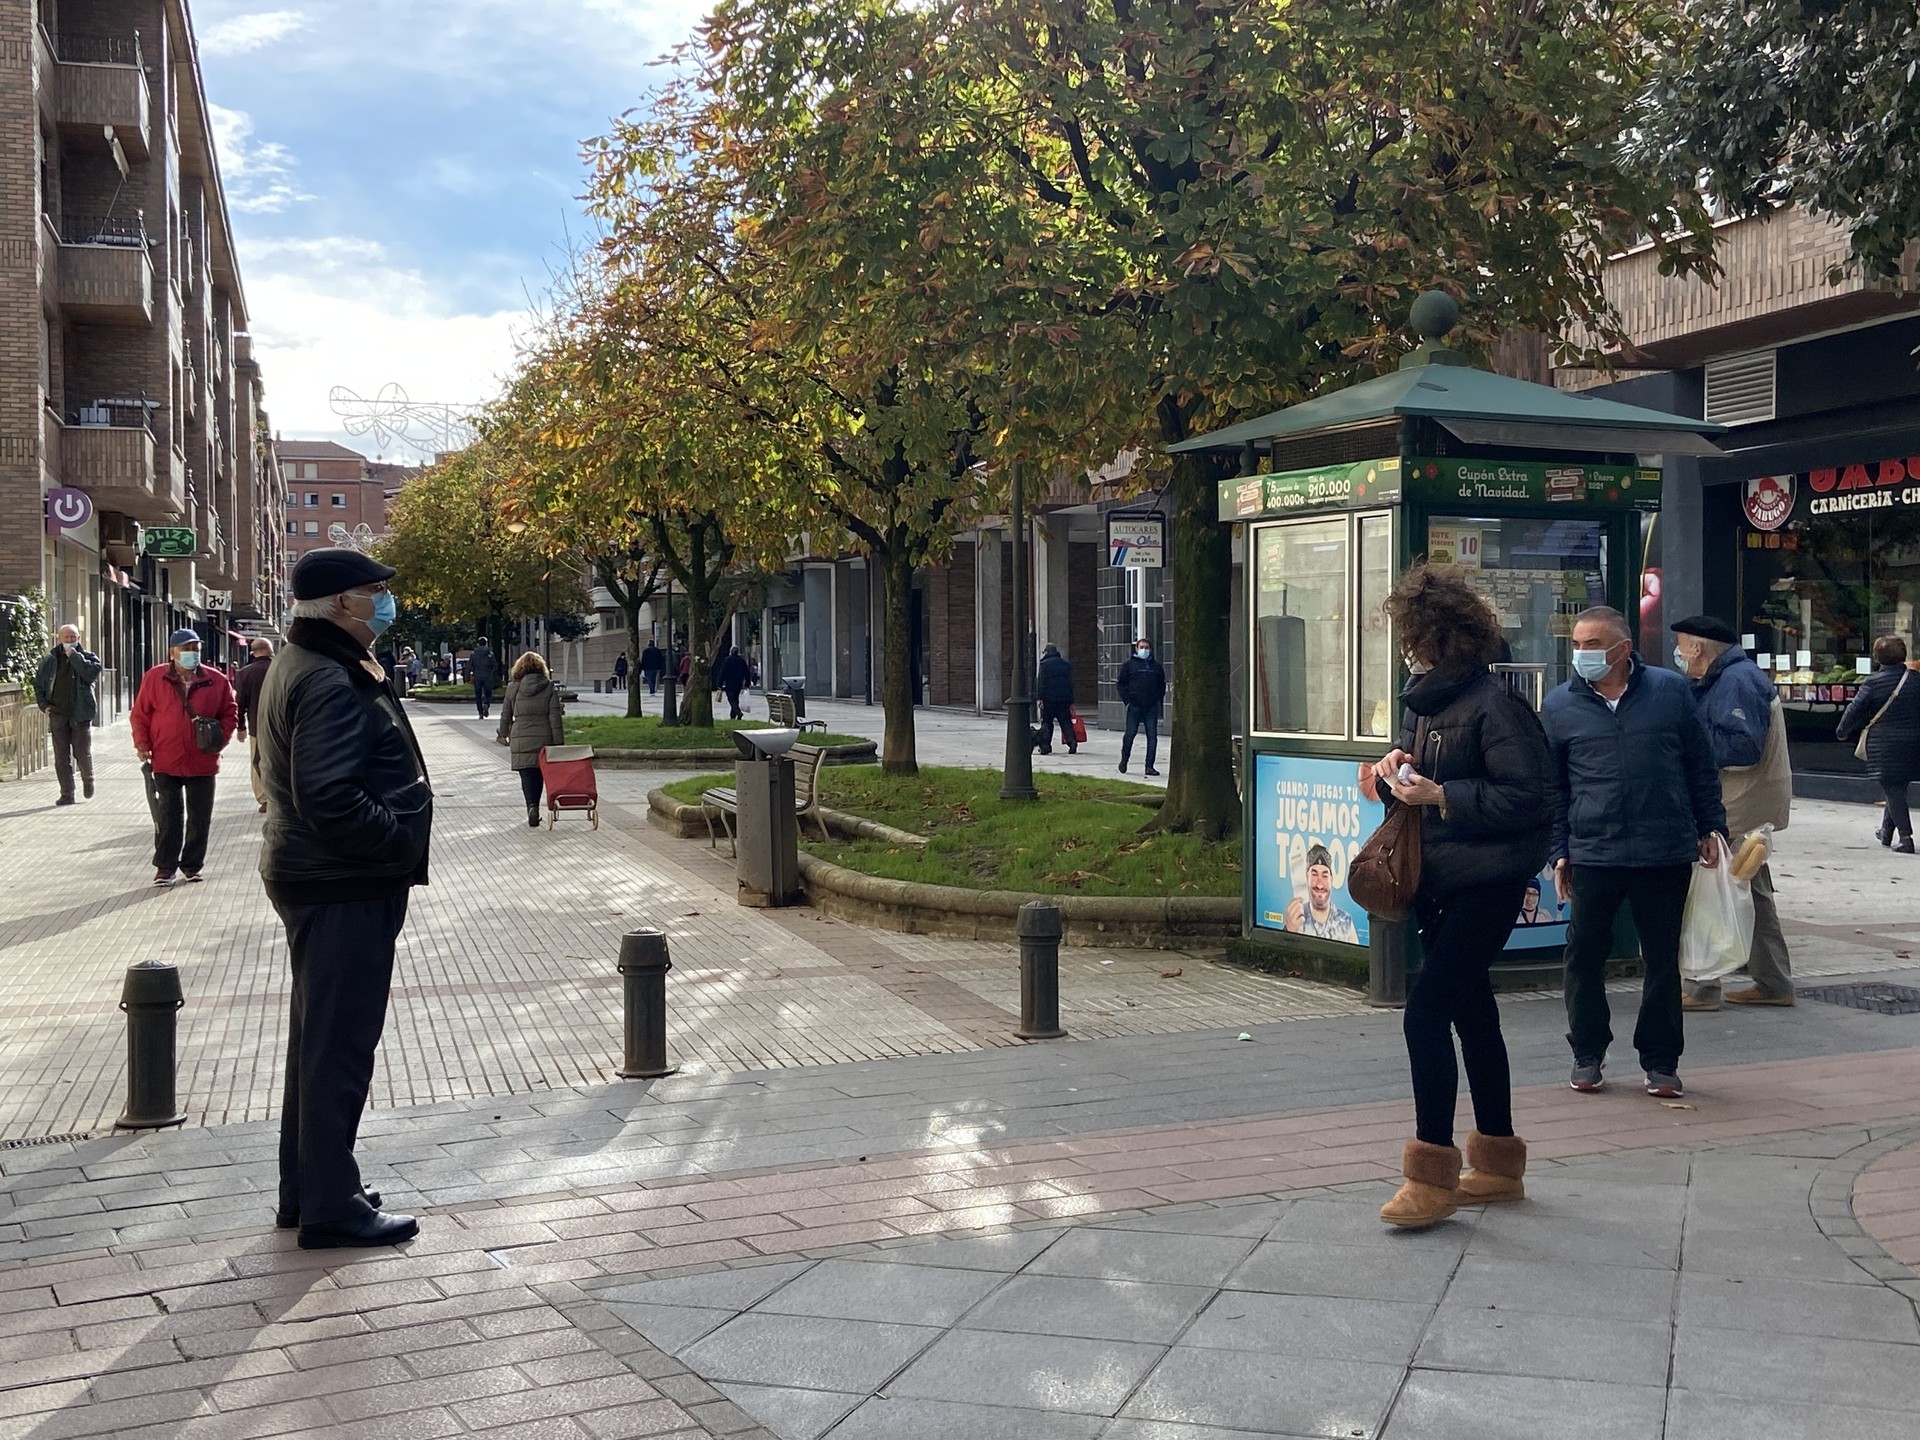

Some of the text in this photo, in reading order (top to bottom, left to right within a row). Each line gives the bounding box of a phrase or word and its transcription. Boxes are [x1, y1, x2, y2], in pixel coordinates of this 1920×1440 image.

[1457, 466, 1528, 485] Cupón Extra
[1308, 479, 1351, 497] 910.000
[1458, 483, 1529, 499] de Navidad.
[1751, 501, 1785, 521] JABUGO
[1113, 525, 1158, 533] AUTOCARES
[1460, 537, 1478, 556] 10
[1276, 781, 1309, 797] CUANDO
[1312, 784, 1343, 800] JUEGAS
[1276, 798, 1360, 838] JUGAMOS
